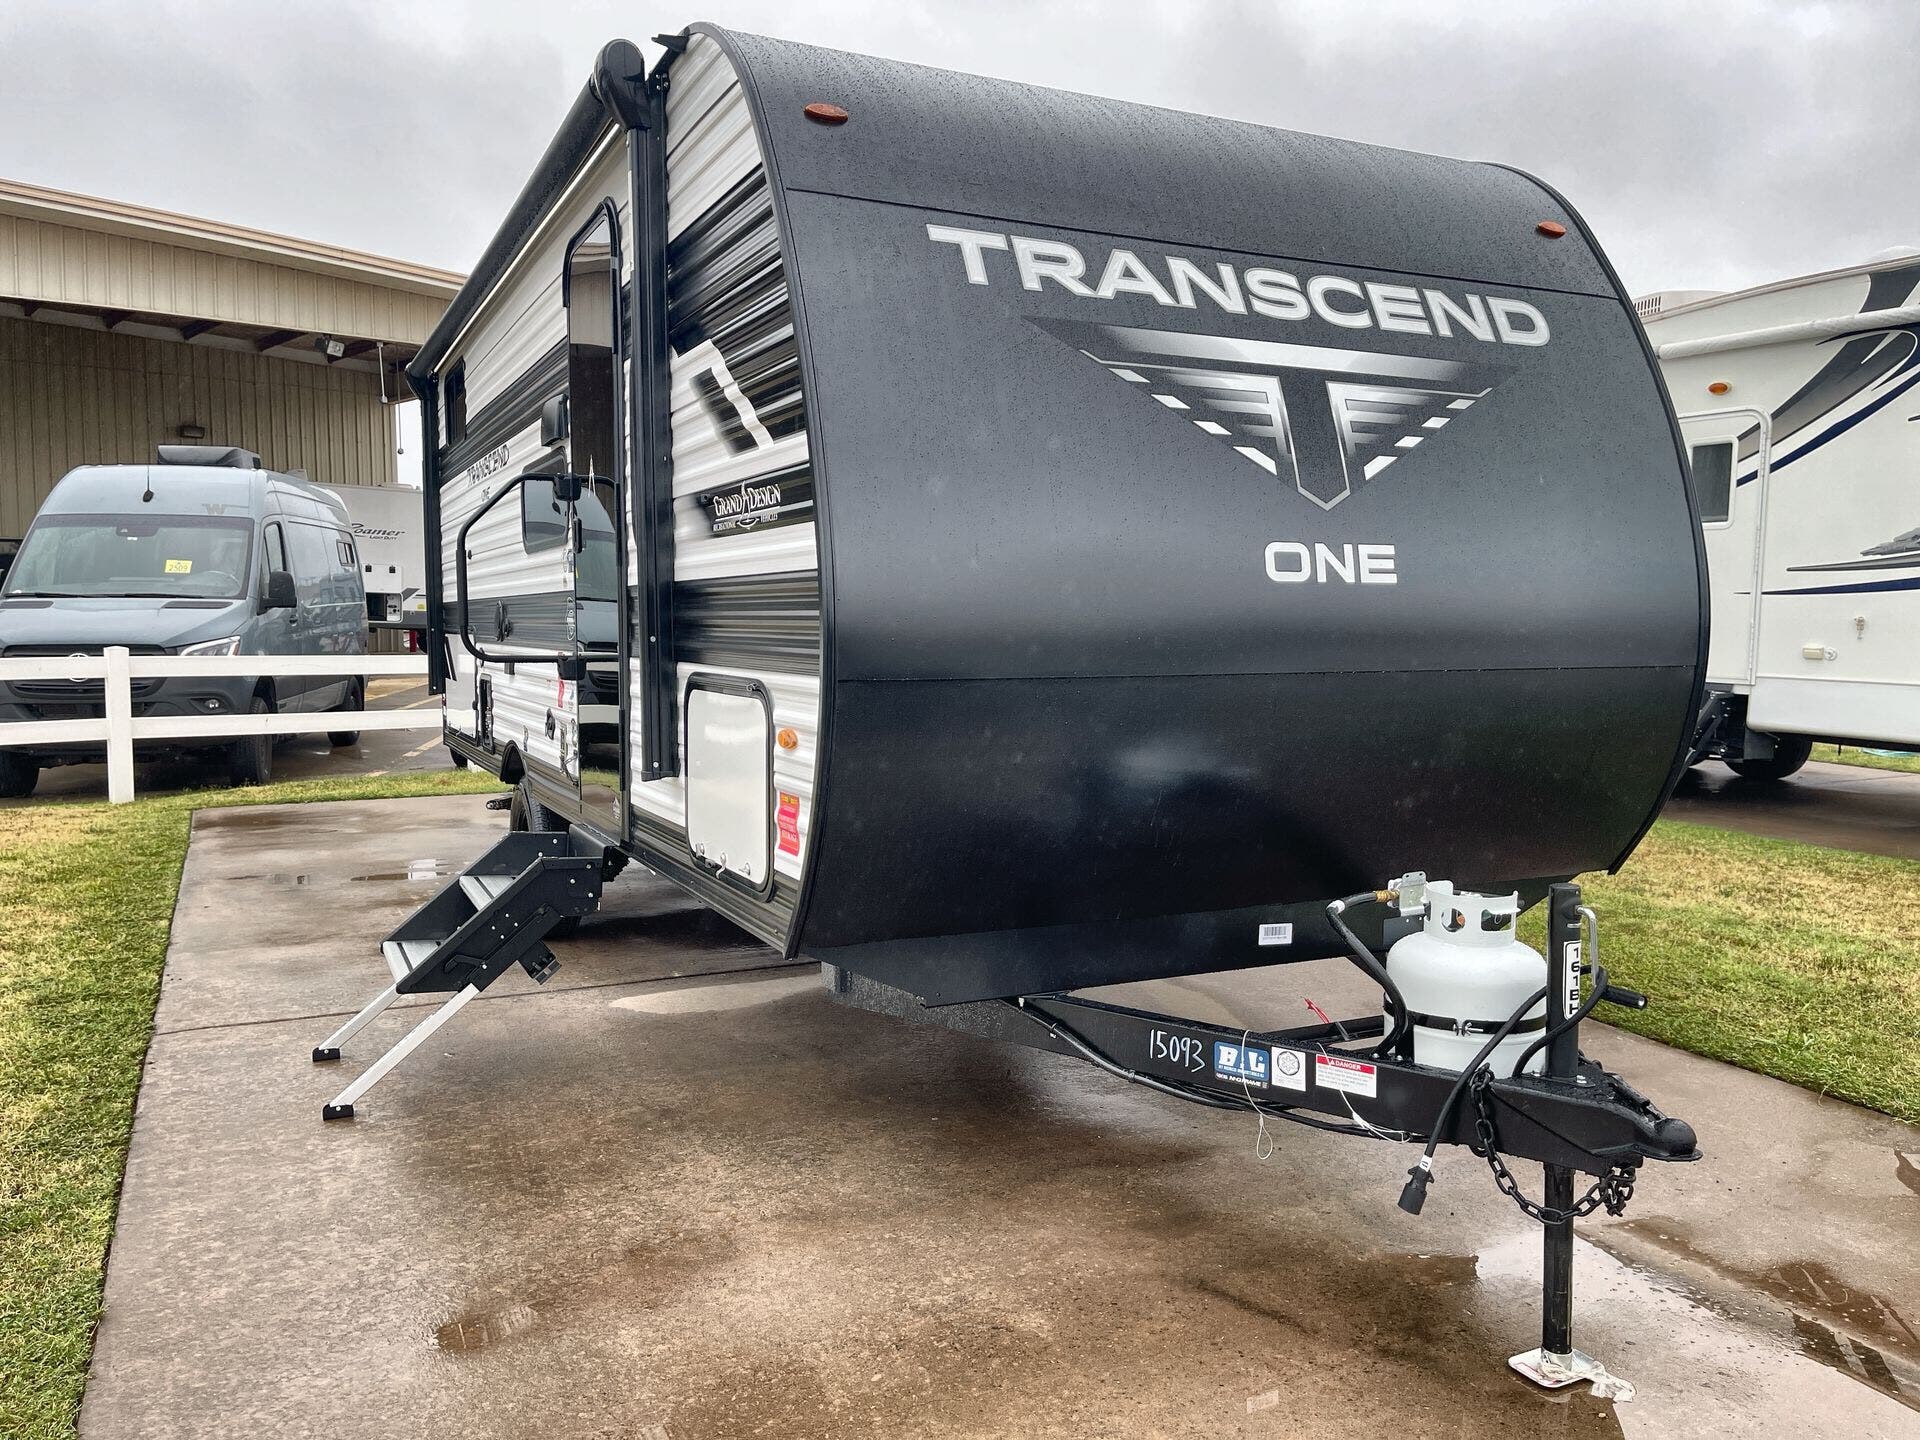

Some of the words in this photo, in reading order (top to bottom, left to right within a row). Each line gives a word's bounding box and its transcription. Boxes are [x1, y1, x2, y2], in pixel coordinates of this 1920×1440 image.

[926, 223, 1551, 347] TRANSCEND
[467, 444, 510, 487] TRANSCEND
[713, 494, 743, 516] GRAND
[749, 483, 781, 509] DESIGN
[1264, 541, 1398, 584] ONE
[1149, 1029, 1206, 1072] 15093
[1335, 1060, 1362, 1071] DANGER
